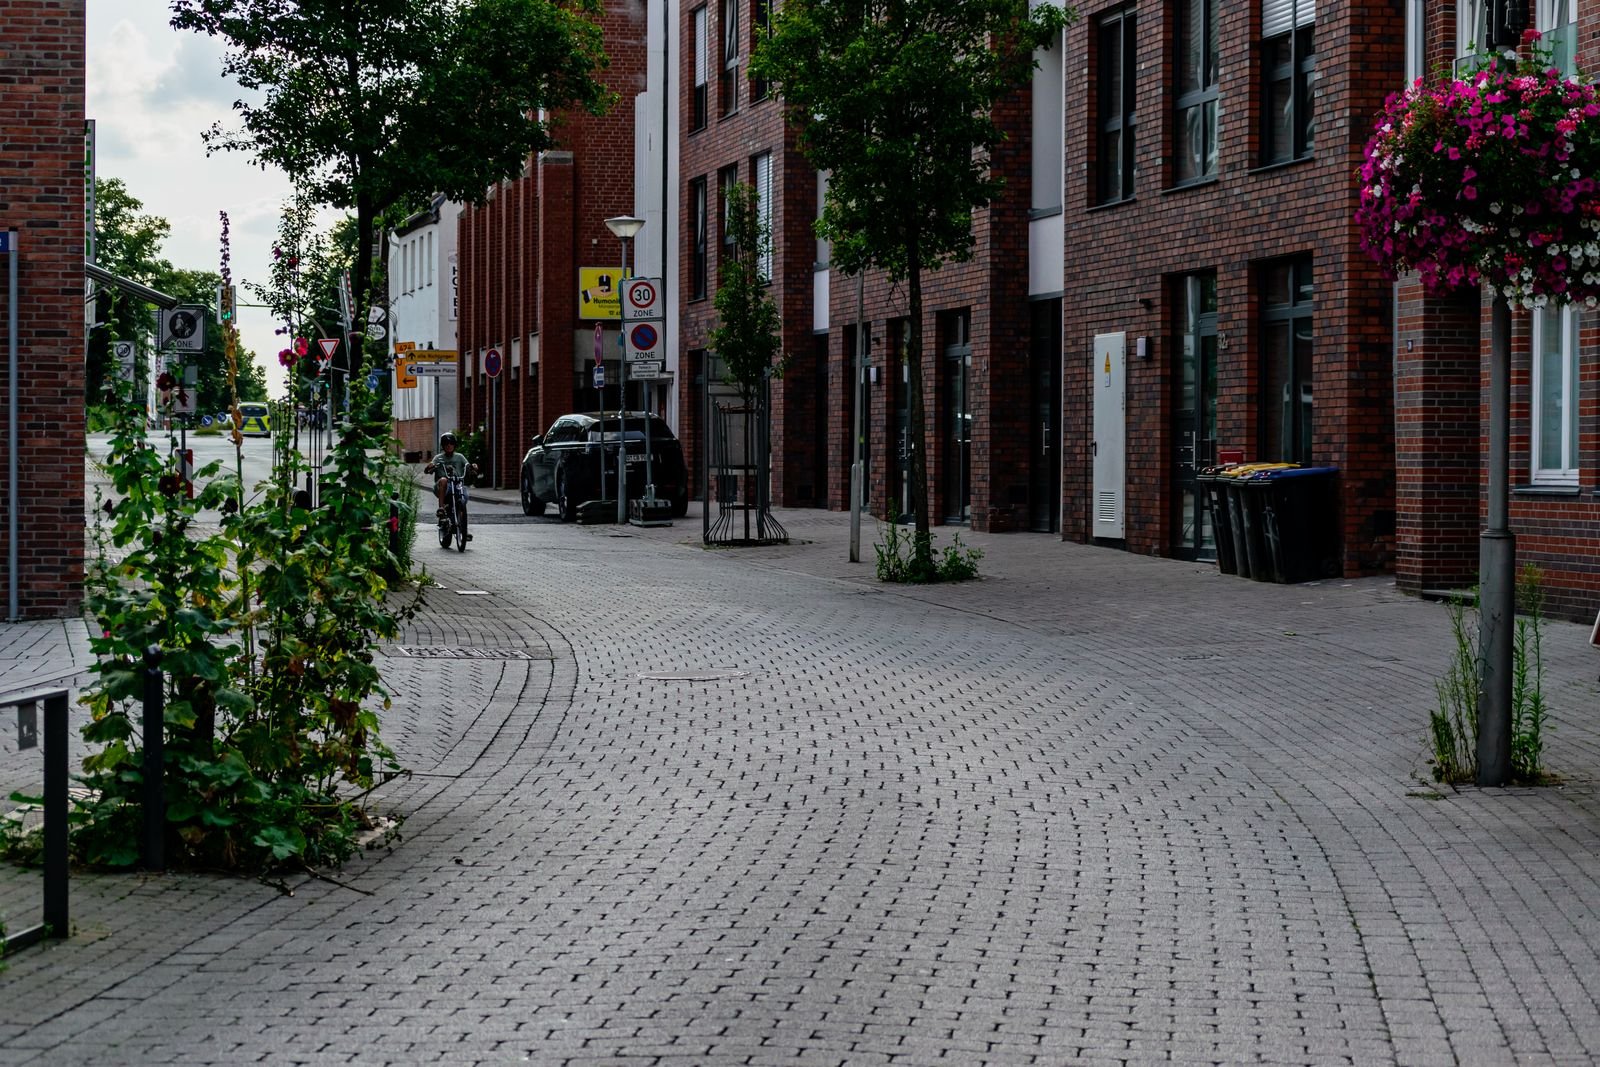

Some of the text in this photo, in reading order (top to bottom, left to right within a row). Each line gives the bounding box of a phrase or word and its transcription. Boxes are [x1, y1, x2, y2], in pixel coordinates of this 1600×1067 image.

[634, 289, 651, 301] 30
[633, 309, 654, 317] ZONE
[174, 340, 193, 348] ONE
